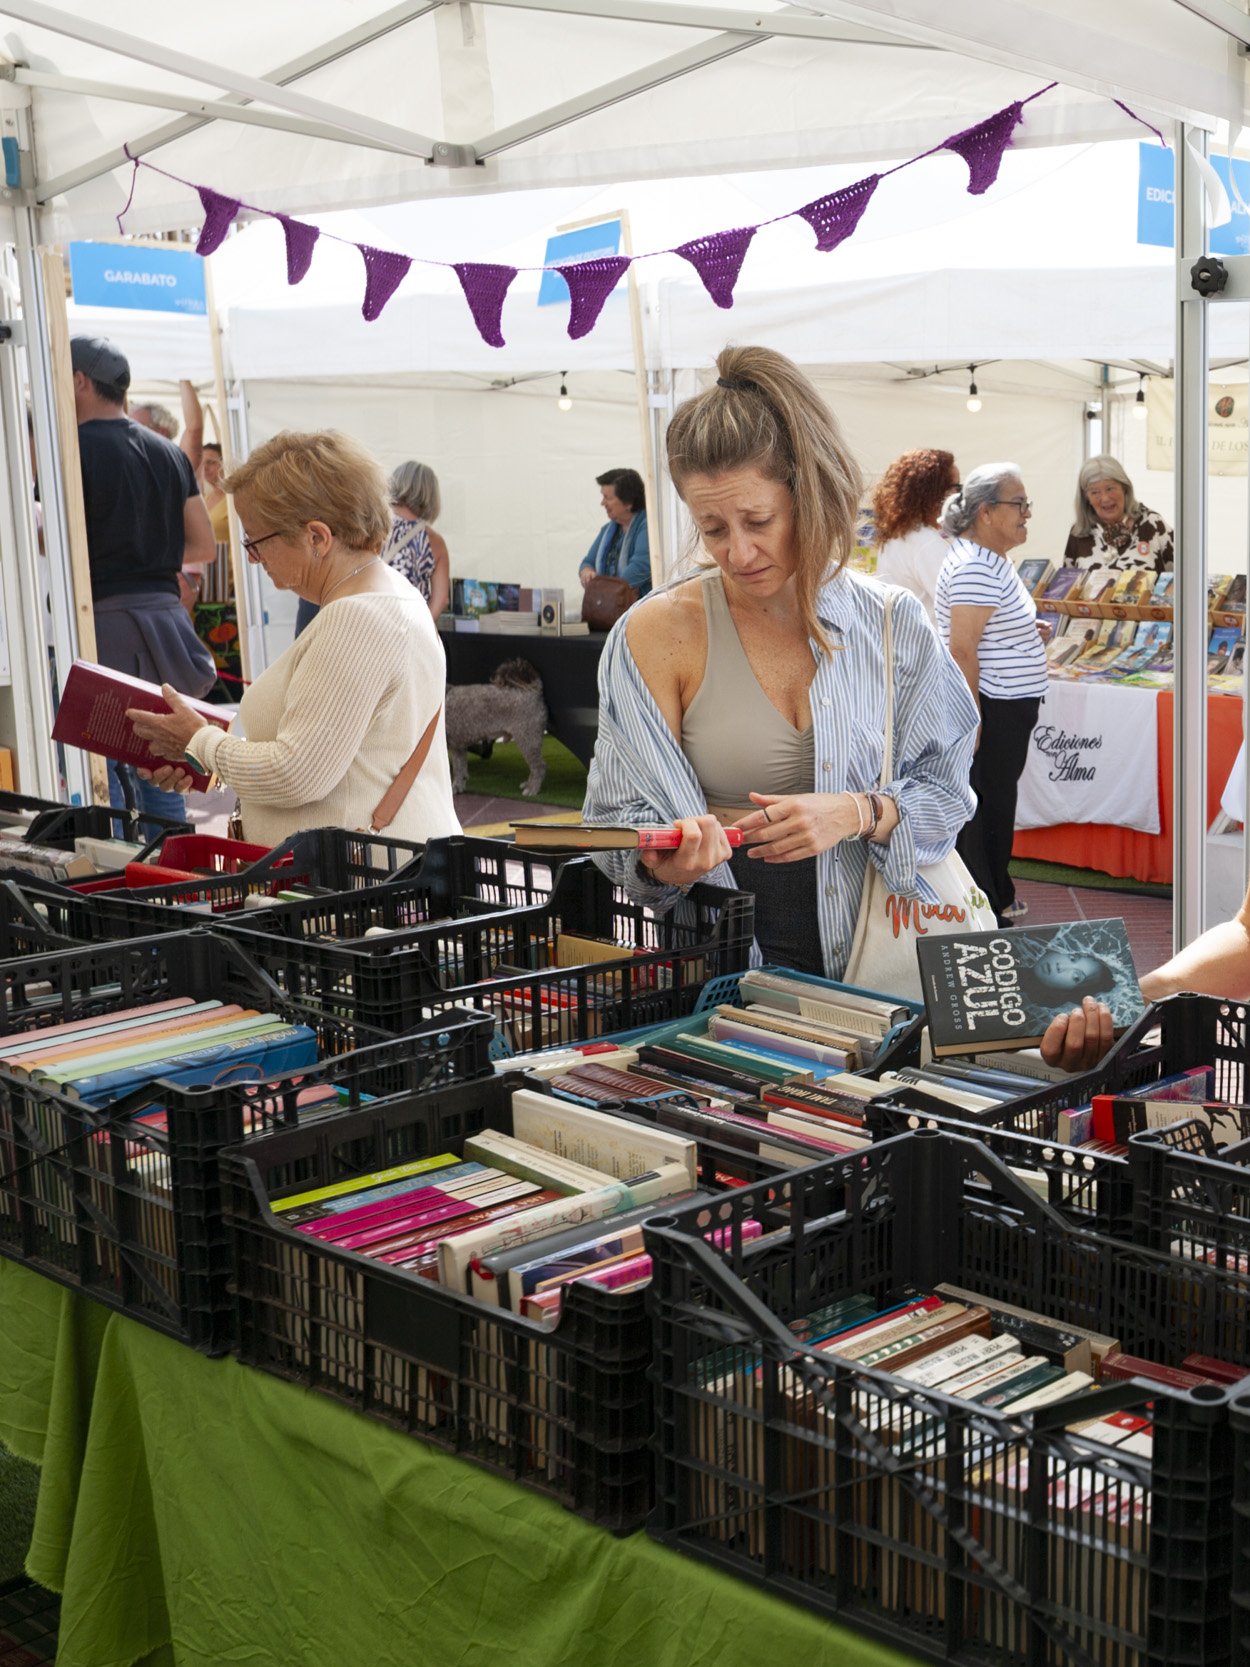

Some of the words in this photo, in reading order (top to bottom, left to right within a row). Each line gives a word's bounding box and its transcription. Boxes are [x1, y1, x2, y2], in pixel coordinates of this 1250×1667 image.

[104, 269, 177, 288] GARABATO
[1034, 725, 1102, 753] Ediciones
[1048, 750, 1096, 782] Alma
[940, 945, 956, 988] ANDREW
[950, 994, 962, 1030] GROSS
[953, 942, 1000, 1030] AZUL
